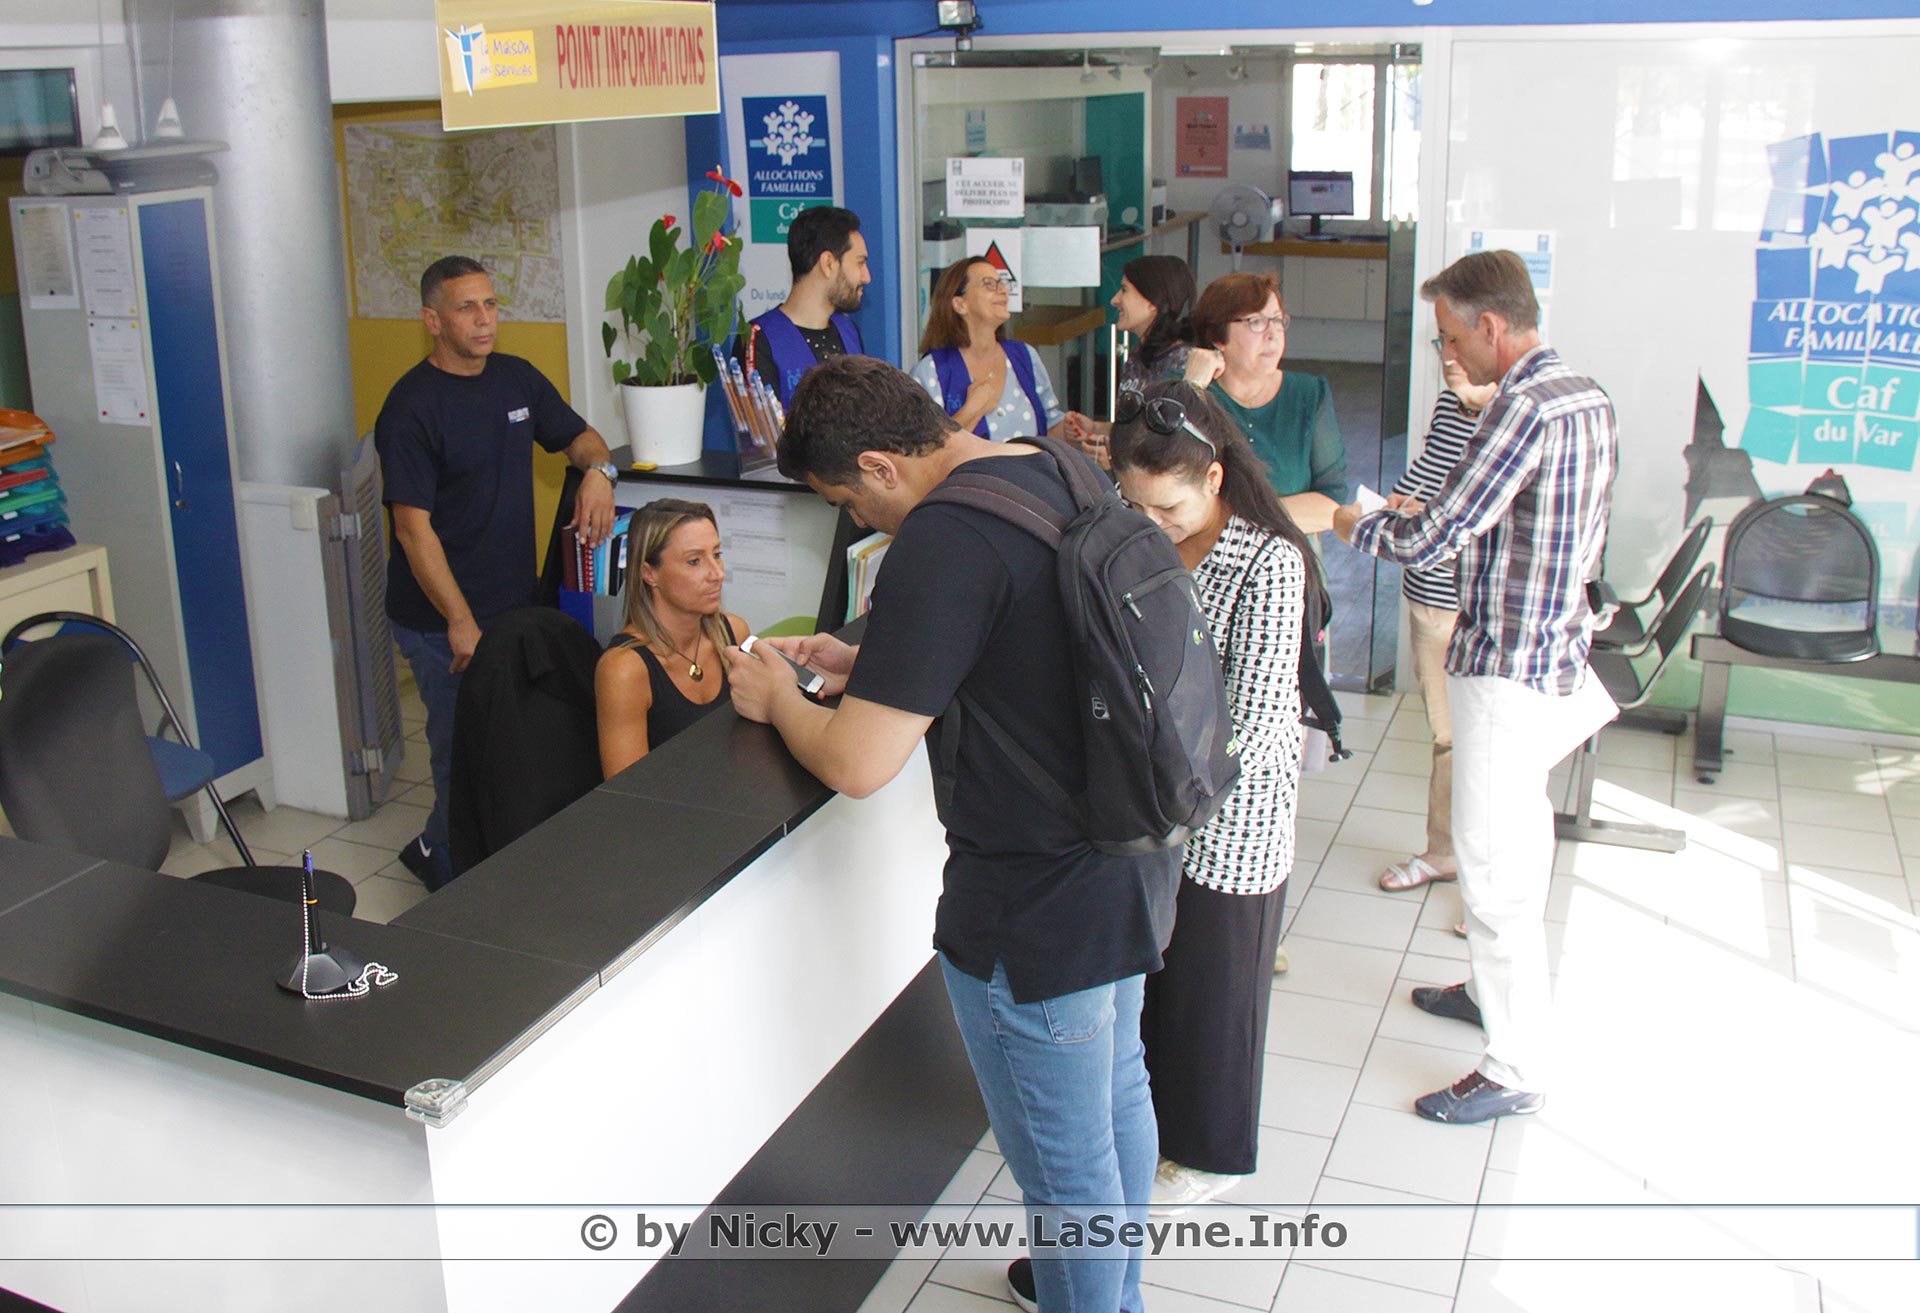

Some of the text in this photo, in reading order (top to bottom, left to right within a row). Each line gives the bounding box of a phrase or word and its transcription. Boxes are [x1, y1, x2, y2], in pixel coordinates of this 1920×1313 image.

[493, 38, 531, 56] Maison
[556, 24, 705, 90] POINT INFORMATIONS
[754, 169, 824, 181] ALLOCATIONS
[760, 181, 816, 193] FAMILIALES
[751, 288, 762, 300] Du
[1827, 376, 1901, 411] Caf
[1814, 418, 1903, 446] du Var
